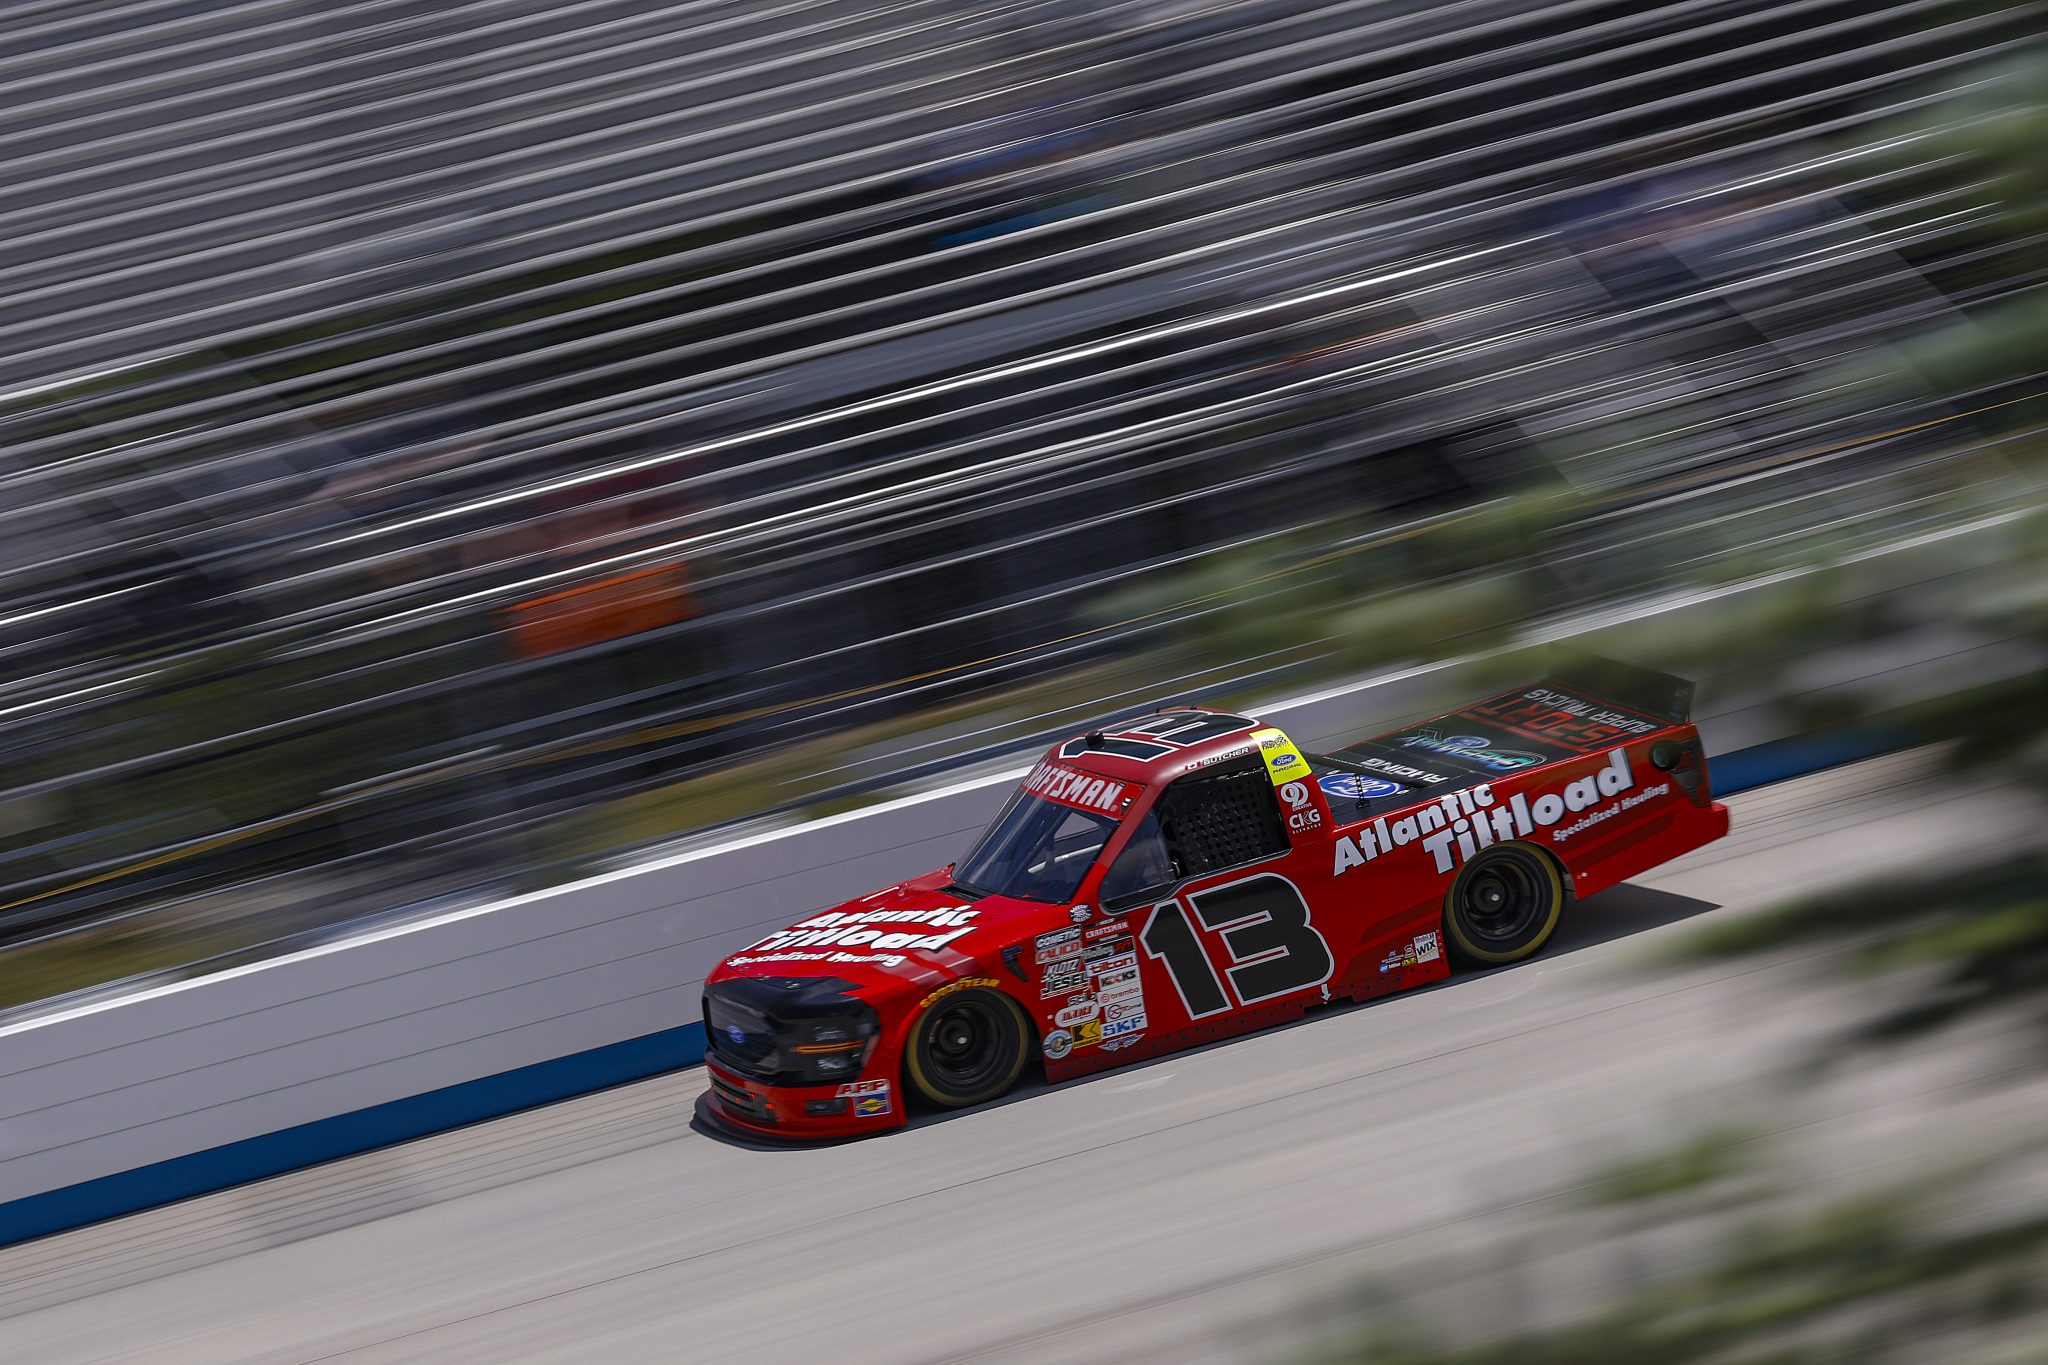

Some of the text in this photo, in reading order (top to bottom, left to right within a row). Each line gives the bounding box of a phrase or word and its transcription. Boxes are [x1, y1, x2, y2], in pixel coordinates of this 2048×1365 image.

[1523, 688, 1658, 734] SUPER TRUCKS
[1059, 710, 1260, 762] 13
[1203, 747, 1249, 766] BUTCHER
[1272, 763, 1302, 773] RACING
[1292, 802, 1312, 811] CREATIVE
[1422, 747, 1634, 874] Tiltload
[1553, 783, 1669, 841] Specialized Hauling
[1292, 823, 1321, 834] ELEVATOR
[1334, 784, 1496, 876] Atlantic
[794, 905, 981, 927] Atlantic
[738, 924, 978, 952] Tiltload
[1036, 928, 1080, 948] COMETIC
[1085, 921, 1128, 939] CRAFTSMAN
[1082, 945, 1114, 960] Holley
[1139, 872, 1335, 1020] 13
[1416, 940, 1436, 955] WIX
[727, 951, 907, 967] Specialized Hauling
[1045, 959, 1080, 977] KLOTZ
[1089, 956, 1134, 974] tilton
[1040, 973, 1088, 994] JESEL
[1101, 970, 1136, 987] KOOKS
[1110, 987, 1139, 999] brembo
[1103, 1015, 1144, 1037] SKF
